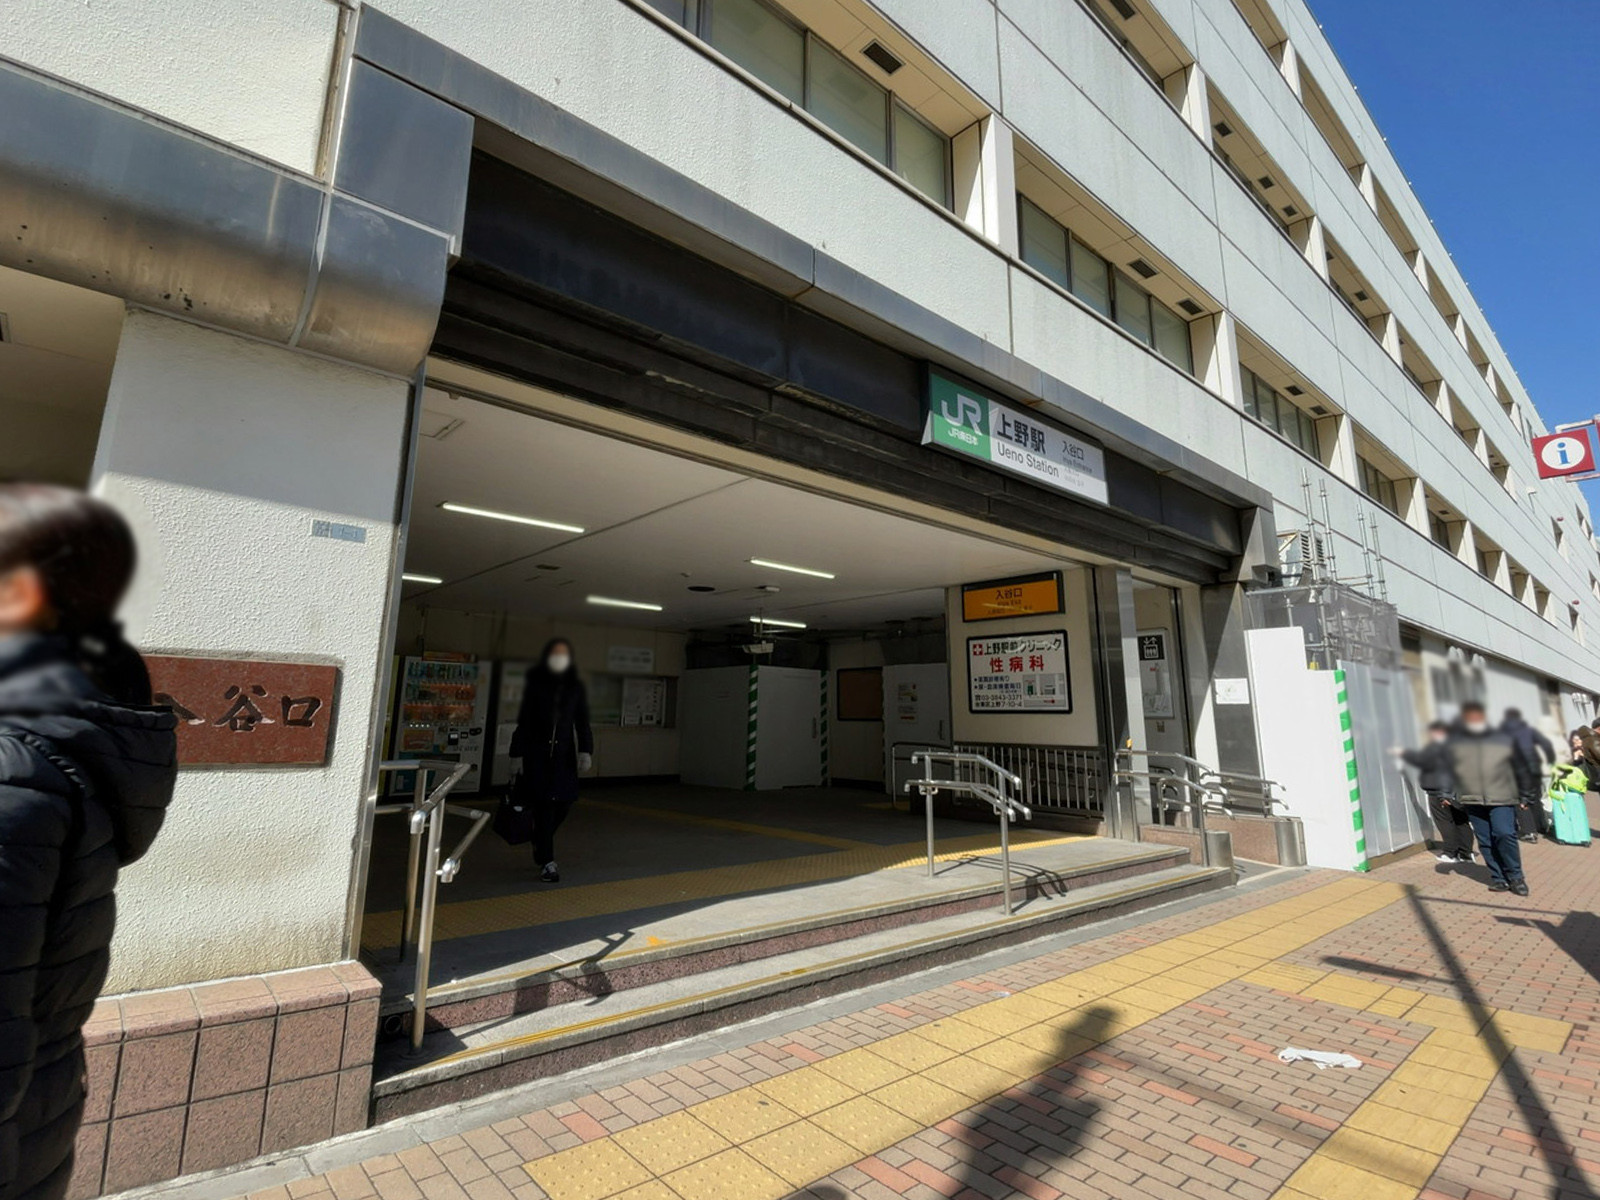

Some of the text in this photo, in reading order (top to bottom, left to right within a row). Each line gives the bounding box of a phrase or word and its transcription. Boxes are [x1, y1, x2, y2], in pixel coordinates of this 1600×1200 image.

[941, 393, 983, 436] JR
[997, 413, 1046, 455] 上野駅
[997, 442, 1024, 464] Ueno
[1026, 453, 1060, 478] Station
[1062, 440, 1085, 461] 入谷口
[995, 588, 1023, 600] 入谷口
[989, 654, 1044, 673] 性病科
